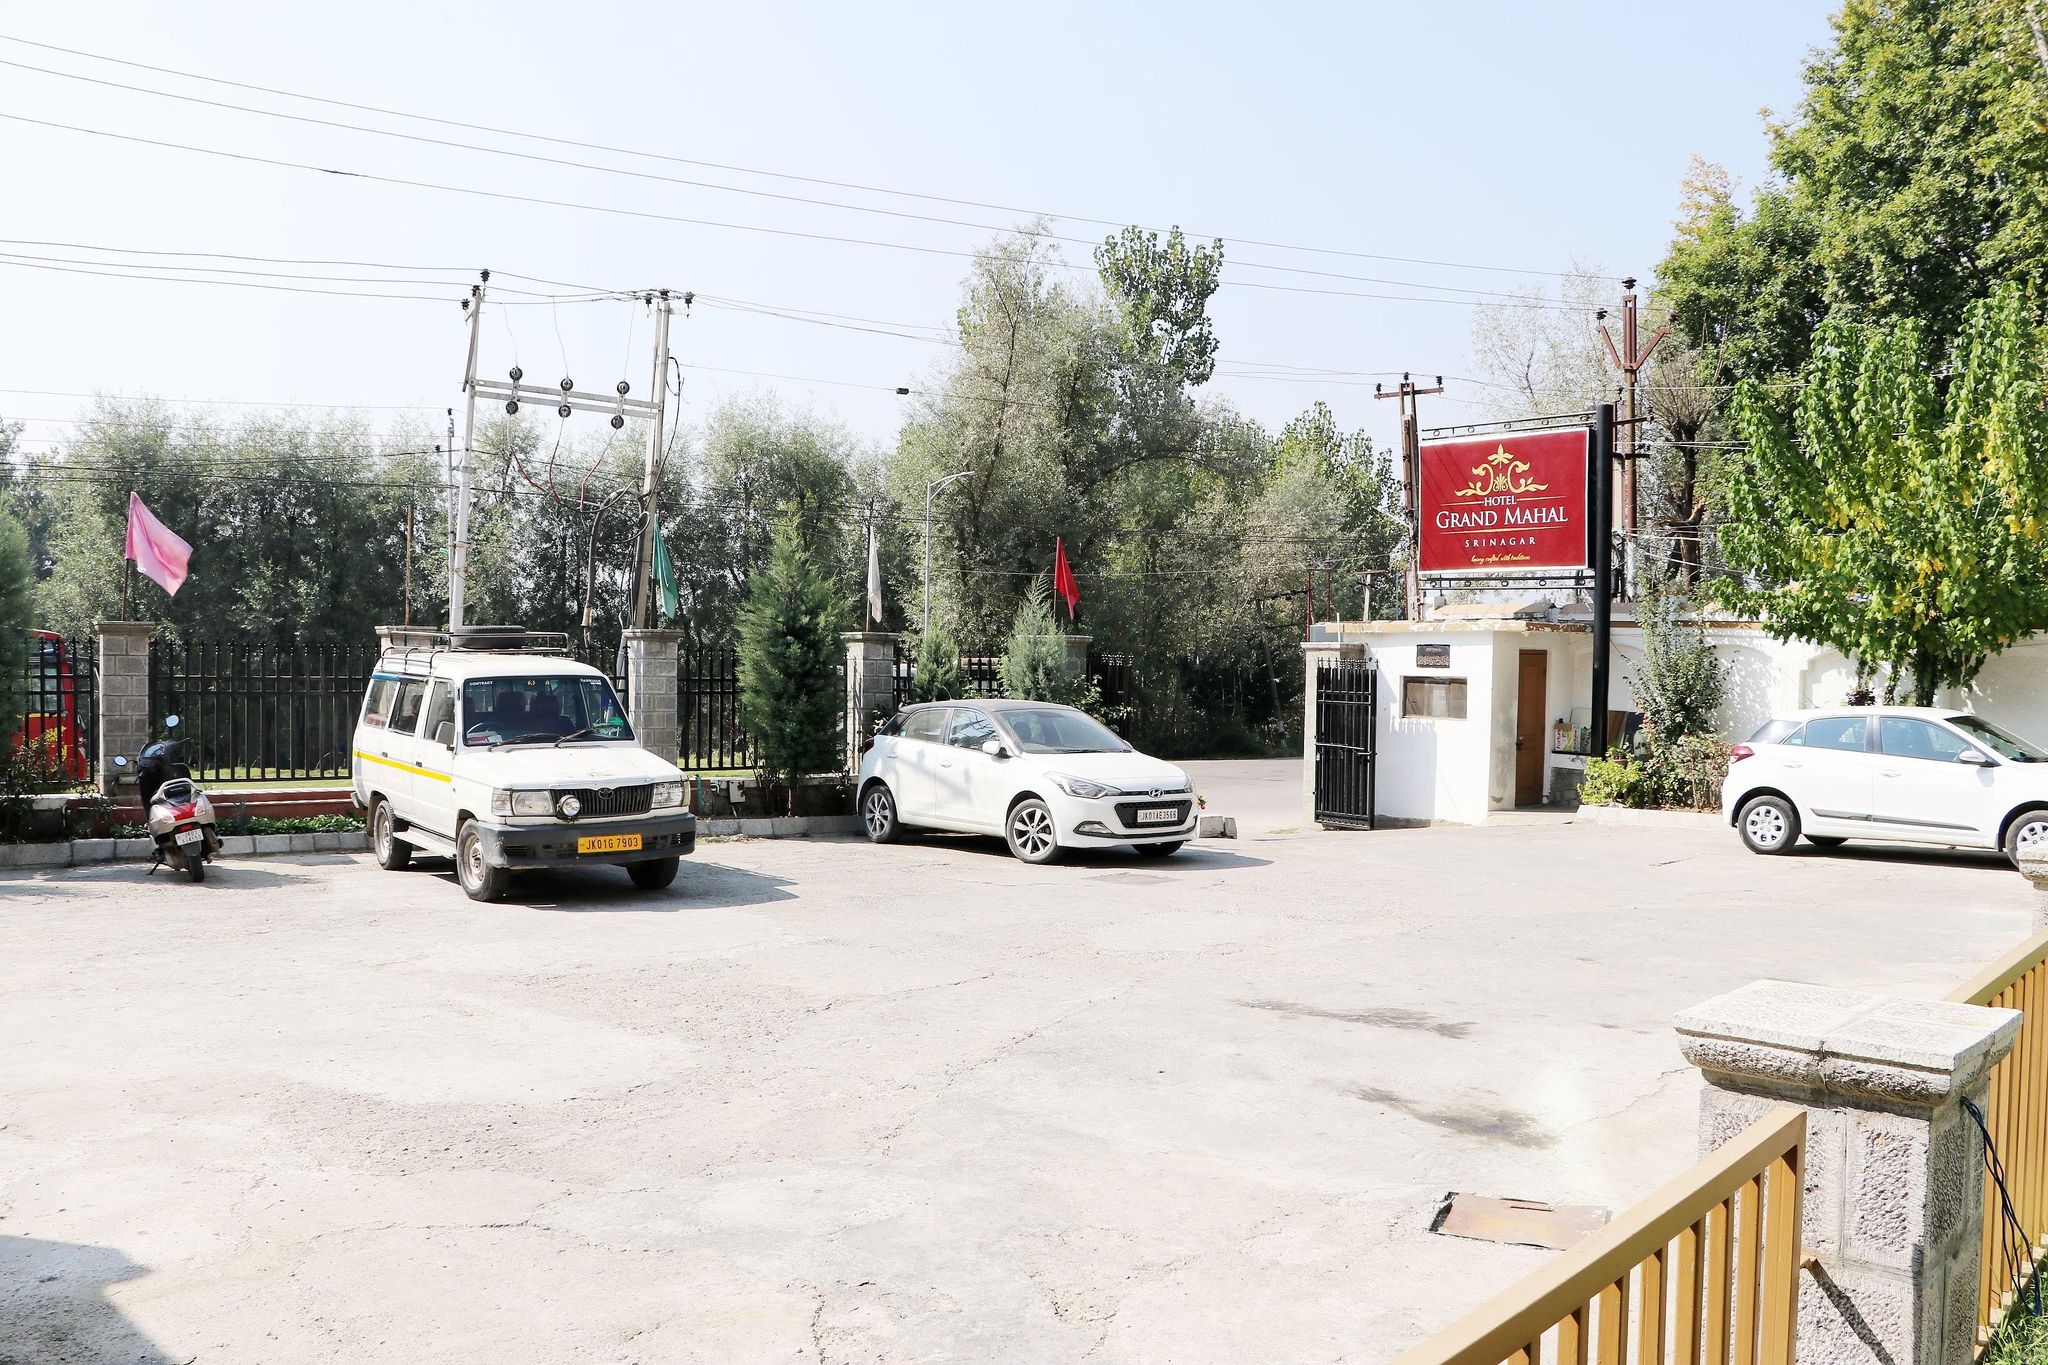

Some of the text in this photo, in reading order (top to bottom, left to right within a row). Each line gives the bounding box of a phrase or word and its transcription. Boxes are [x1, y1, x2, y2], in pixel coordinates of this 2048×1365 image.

[1484, 495, 1517, 507] HOTEL
[1435, 506, 1568, 529] GRAND MAHAL
[1465, 536, 1536, 548] SRINAGAR
[1500, 553, 1511, 561] with
[586, 837, 639, 850] JK01G 7903
